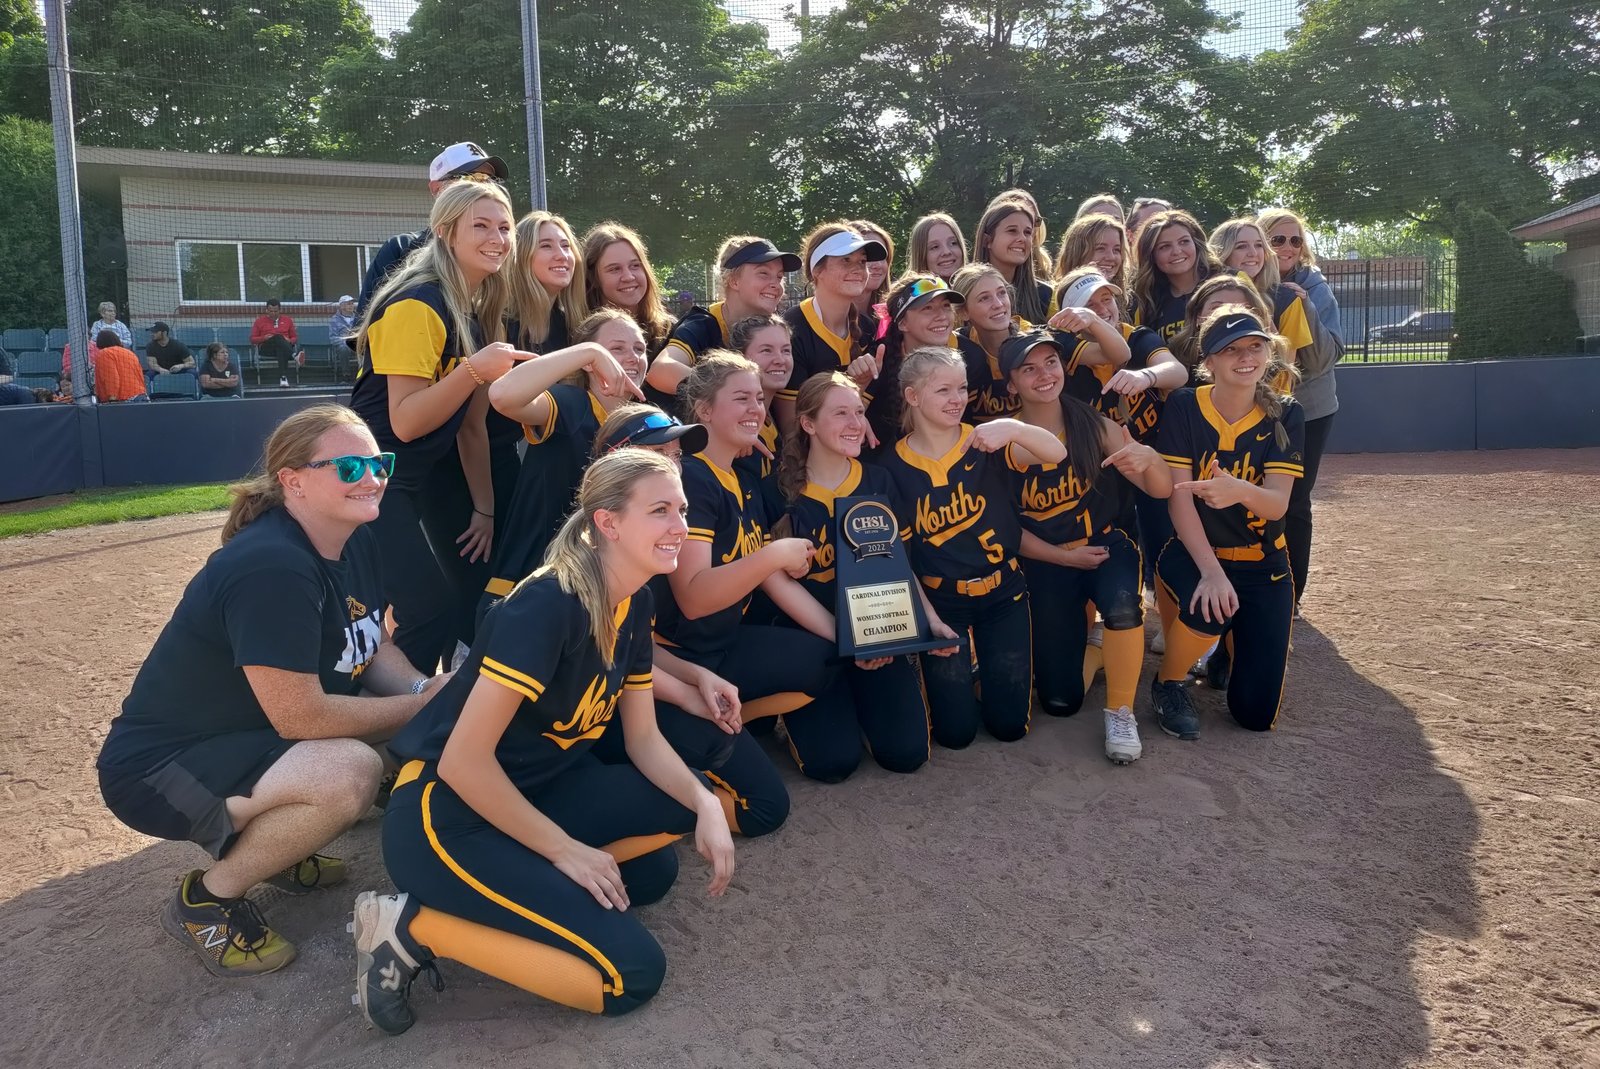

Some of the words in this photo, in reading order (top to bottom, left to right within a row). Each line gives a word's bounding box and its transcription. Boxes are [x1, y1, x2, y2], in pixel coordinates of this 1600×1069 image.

[1135, 403, 1159, 435] 16
[1021, 465, 1092, 510] North
[915, 482, 987, 535] North
[852, 515, 889, 530] CHSL
[1076, 508, 1093, 537] 7
[868, 543, 886, 552] 2022
[978, 529, 1004, 564] 5
[851, 591, 881, 600] CARDINAL
[881, 588, 907, 597] DIVISION
[856, 614, 881, 622] WOMENS
[881, 610, 909, 619] SOFTBALL
[863, 623, 908, 636] CHAMPION
